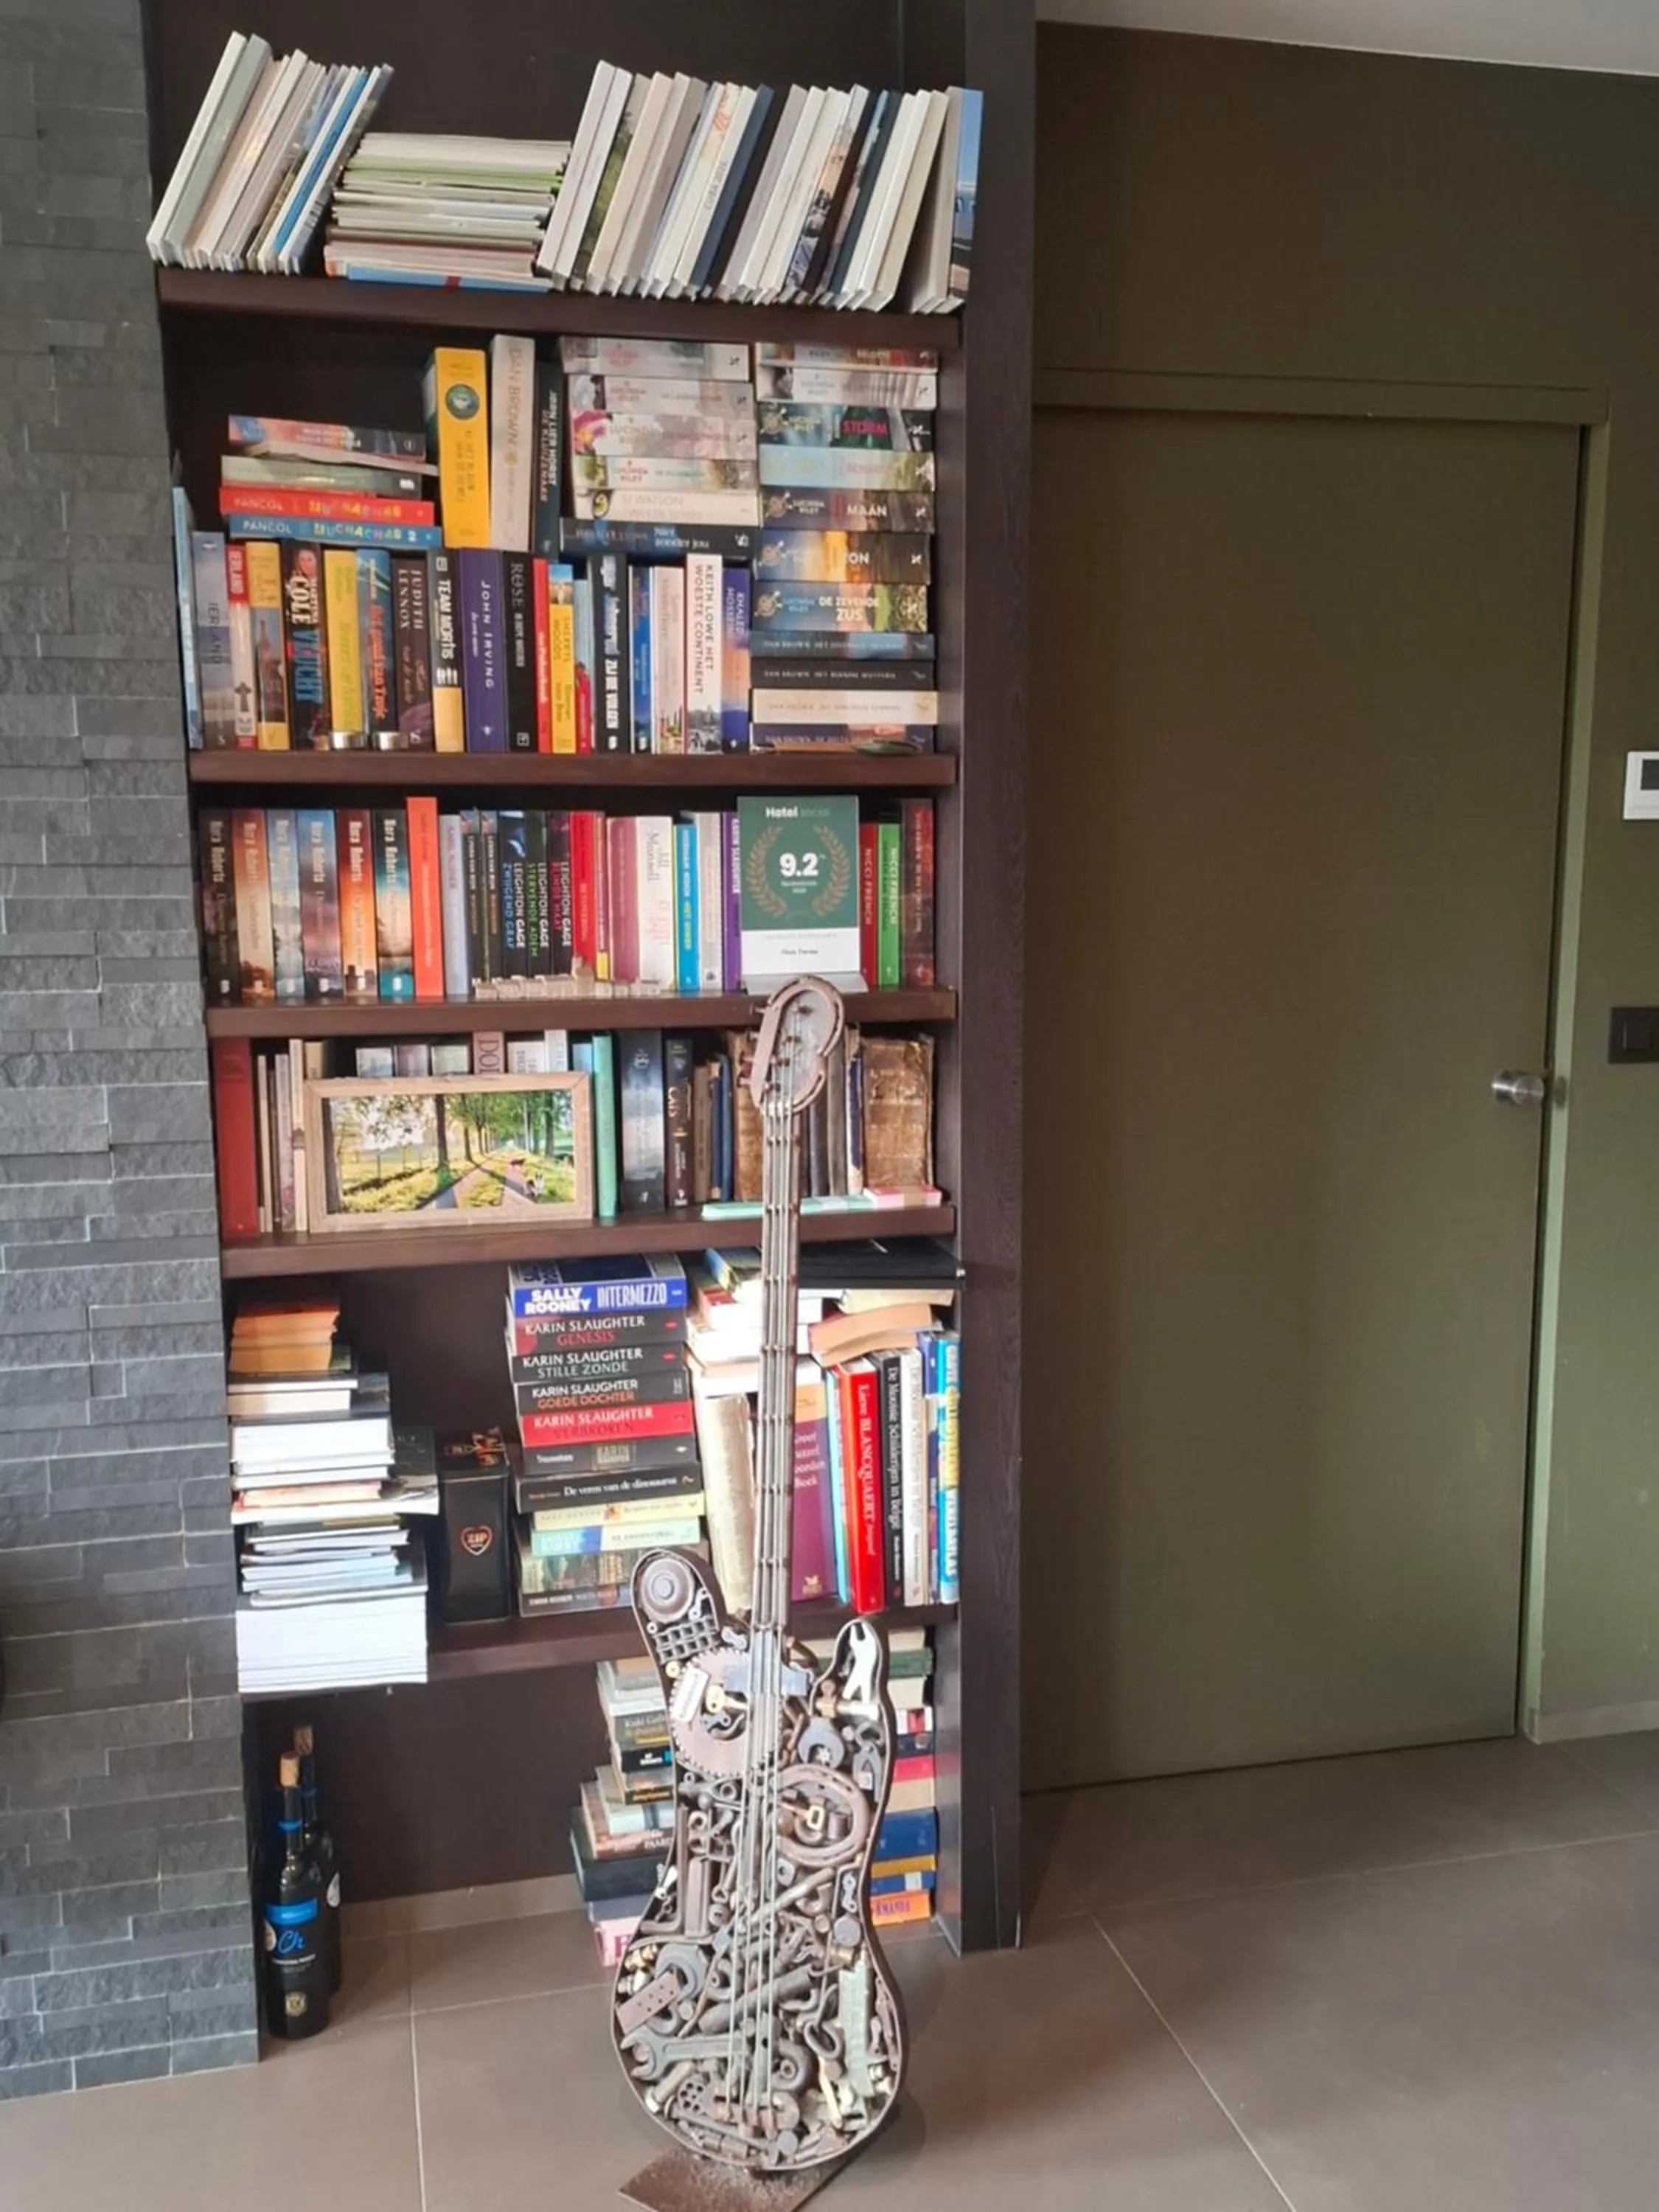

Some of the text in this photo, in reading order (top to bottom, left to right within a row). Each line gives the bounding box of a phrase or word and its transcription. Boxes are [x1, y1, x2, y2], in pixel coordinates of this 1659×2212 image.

[507, 386, 521, 447] BROWN
[842, 420, 888, 434] STORM
[234, 498, 402, 518] PANCOL MUCHACHAS
[846, 504, 888, 518] MAAN
[242, 520, 419, 542] PANCOL MUCHACHAS 2
[229, 550, 245, 595] IERLAND
[290, 575, 311, 625] COLE
[398, 568, 411, 630] LENNOX
[411, 569, 423, 630] JUDITH
[437, 579, 454, 612] TEAM
[818, 596, 880, 608] DE ZEVENDE
[207, 602, 222, 665] IERLAND
[695, 564, 704, 695] WOESTE CONTINENT
[704, 564, 714, 671] KEITH LOWE HET
[835, 608, 864, 622] ZUS
[481, 580, 495, 689] JOHN IRVING
[293, 628, 324, 704] VLUCHT
[765, 805, 799, 818] Hotel
[210, 820, 224, 842] Nora
[212, 846, 226, 883] Roberts
[312, 821, 326, 883] Nora Roberts
[348, 821, 364, 883] Nora Roberts
[383, 818, 399, 883] Nora Roberts
[779, 852, 819, 877] 9.2
[731, 846, 741, 894] SLAUGHTER
[864, 847, 873, 926] NICCI FRENCH
[889, 847, 899, 926] NICCI FRENCH
[512, 862, 526, 949] LEIGHTON GAGE
[527, 862, 539, 957] STERVENDE ADEM
[538, 862, 549, 949] LEIGHTON GAGE
[560, 861, 572, 947] LEIGHTON GAGE
[524, 1298, 592, 1315] ROONEY
[531, 1283, 667, 1309] SALLY INTERMEZZO
[524, 1315, 646, 1336] KARIN SLAUGHTER
[556, 1330, 615, 1346] GENESIS
[522, 1348, 644, 1368] KARIN SLAUGHTER
[537, 1361, 629, 1380] STILLE ZONDE
[887, 1366, 898, 1382] De
[532, 1379, 639, 1399] KARIN SLAUGHTER
[537, 1391, 636, 1410] GOEDE DOCHTER
[534, 1408, 654, 1429] KARIN SLAUGHTER
[857, 1383, 876, 1521] Lieve BLANCQUAERT
[887, 1423, 901, 1484] Schilderijen
[563, 1486, 577, 1497] De
[621, 1479, 632, 1490] de
[891, 1485, 901, 1498] in
